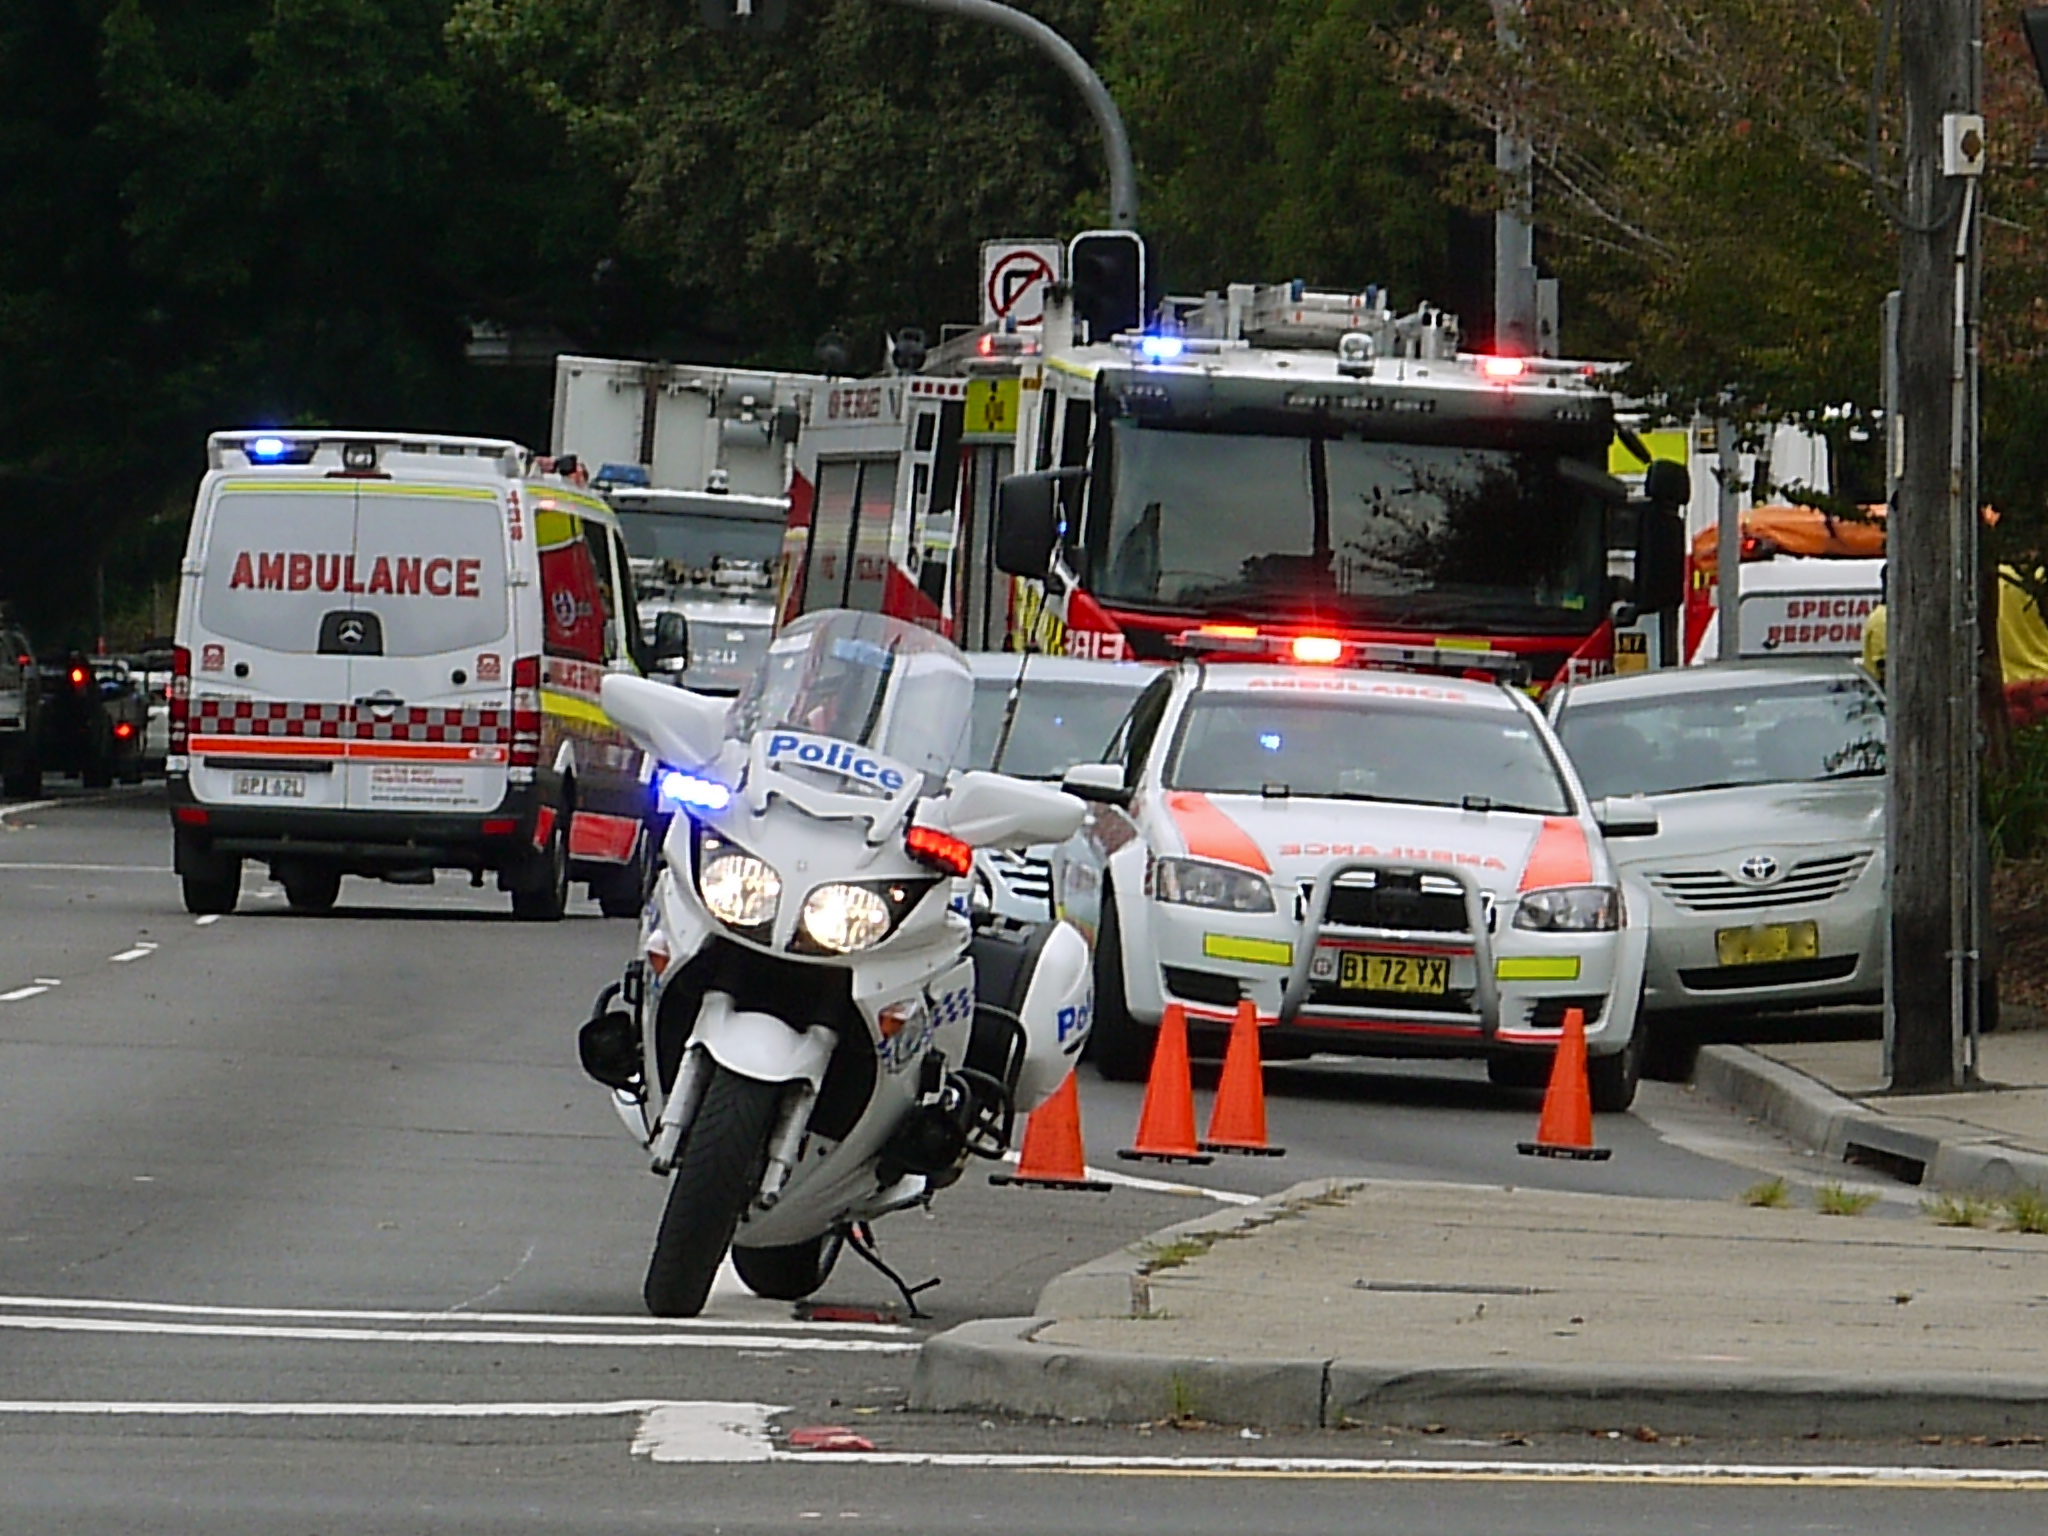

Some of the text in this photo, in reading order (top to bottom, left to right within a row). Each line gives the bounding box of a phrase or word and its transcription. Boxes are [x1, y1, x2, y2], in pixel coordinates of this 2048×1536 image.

[229, 552, 481, 598] AMBULANCE
[1248, 677, 1467, 700] AMBULANCE
[768, 735, 904, 790] Police
[1343, 957, 1443, 989] BI 72 YX
